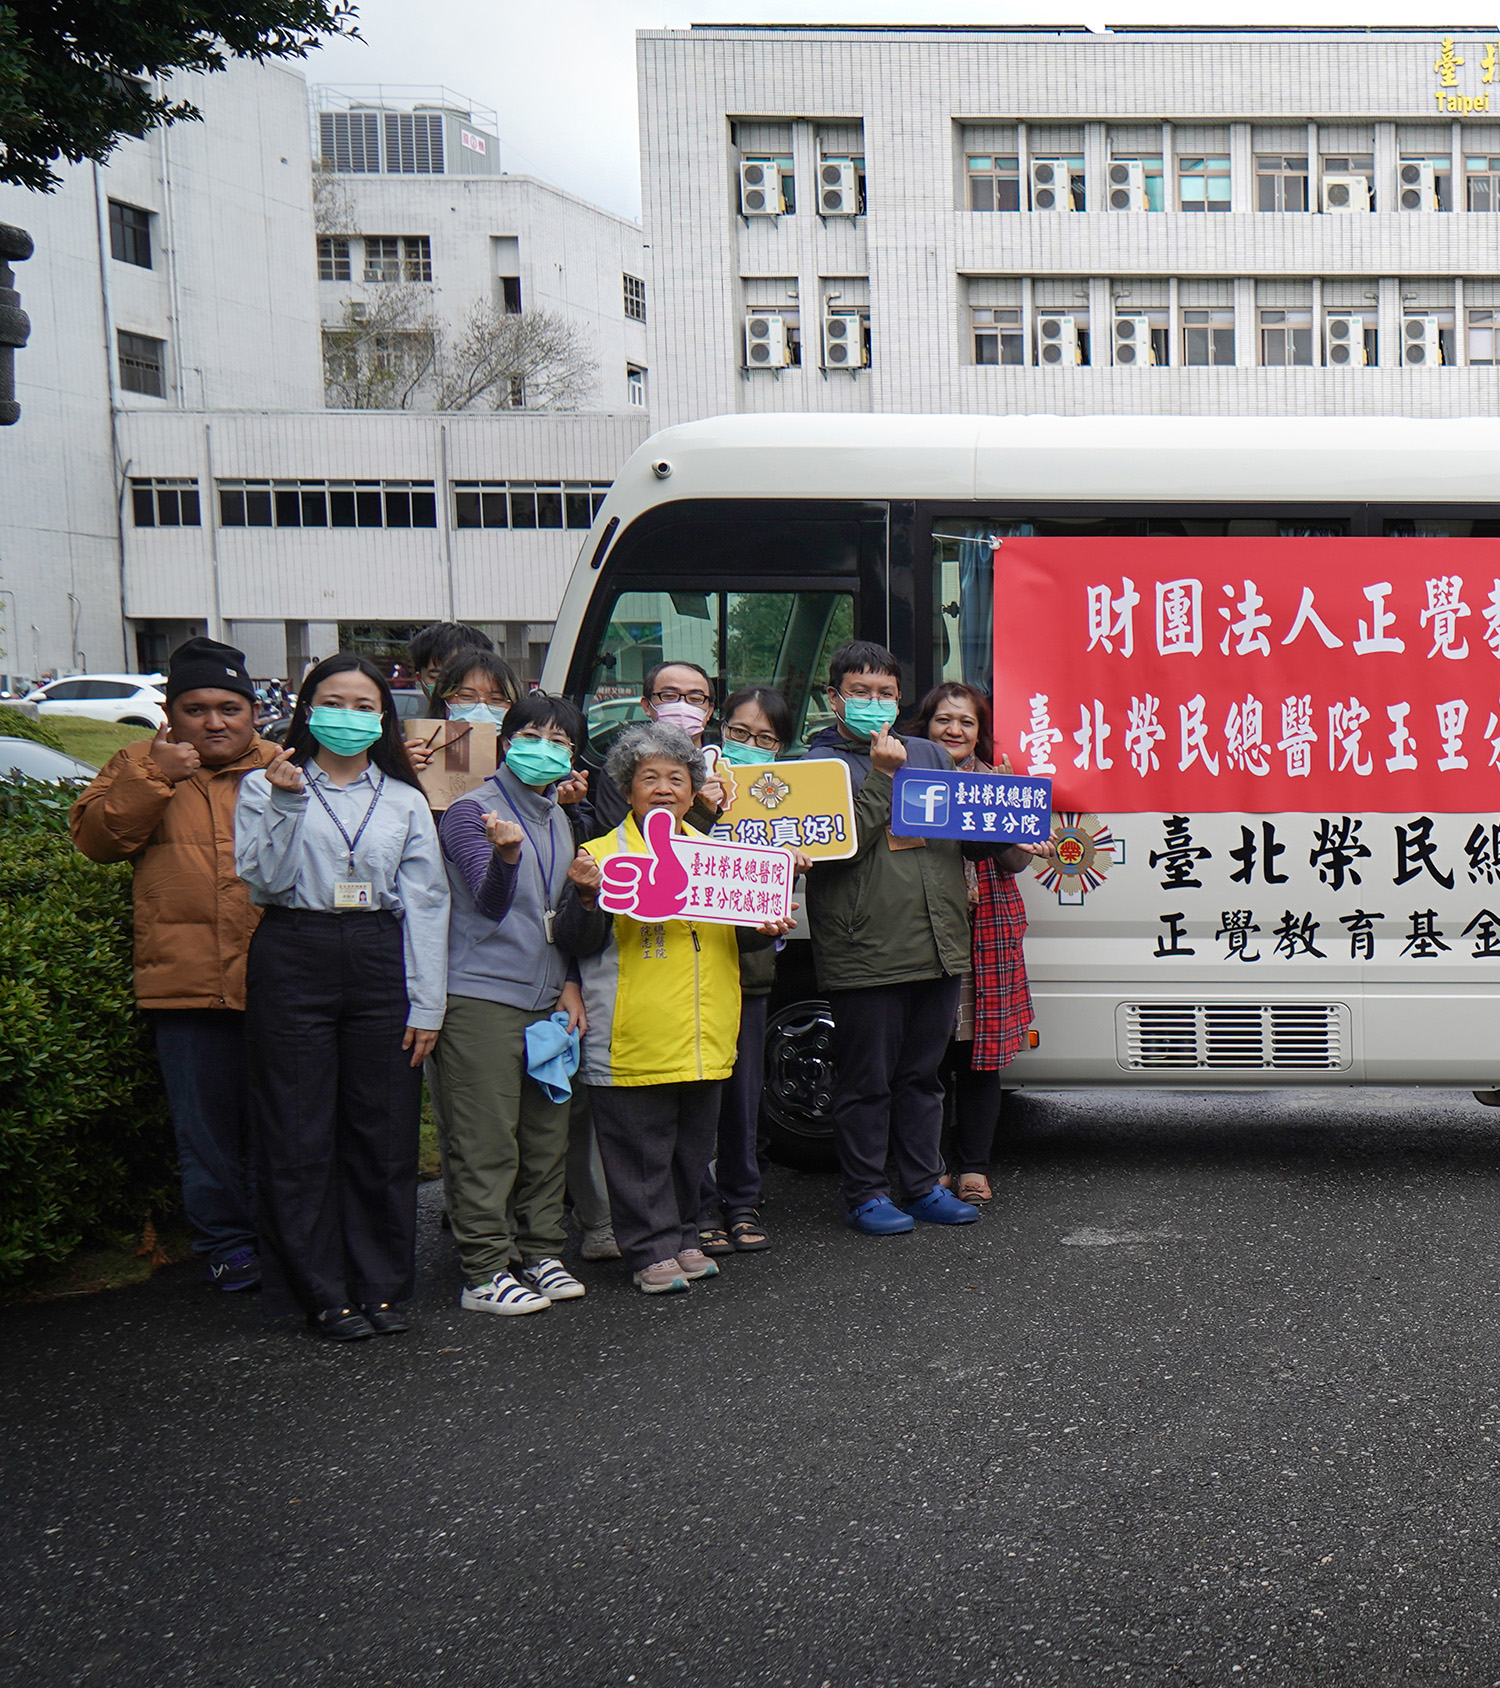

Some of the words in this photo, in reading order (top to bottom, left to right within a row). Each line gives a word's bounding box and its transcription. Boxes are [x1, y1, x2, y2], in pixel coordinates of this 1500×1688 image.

[1435, 91, 1490, 117] Taipei
[955, 782, 1048, 810] 臺北榮民總醫院
[961, 811, 1041, 836] 玉里分院
[690, 852, 785, 886] 臺北榮民總醫院
[689, 885, 783, 916] 玉里分院感謝您
